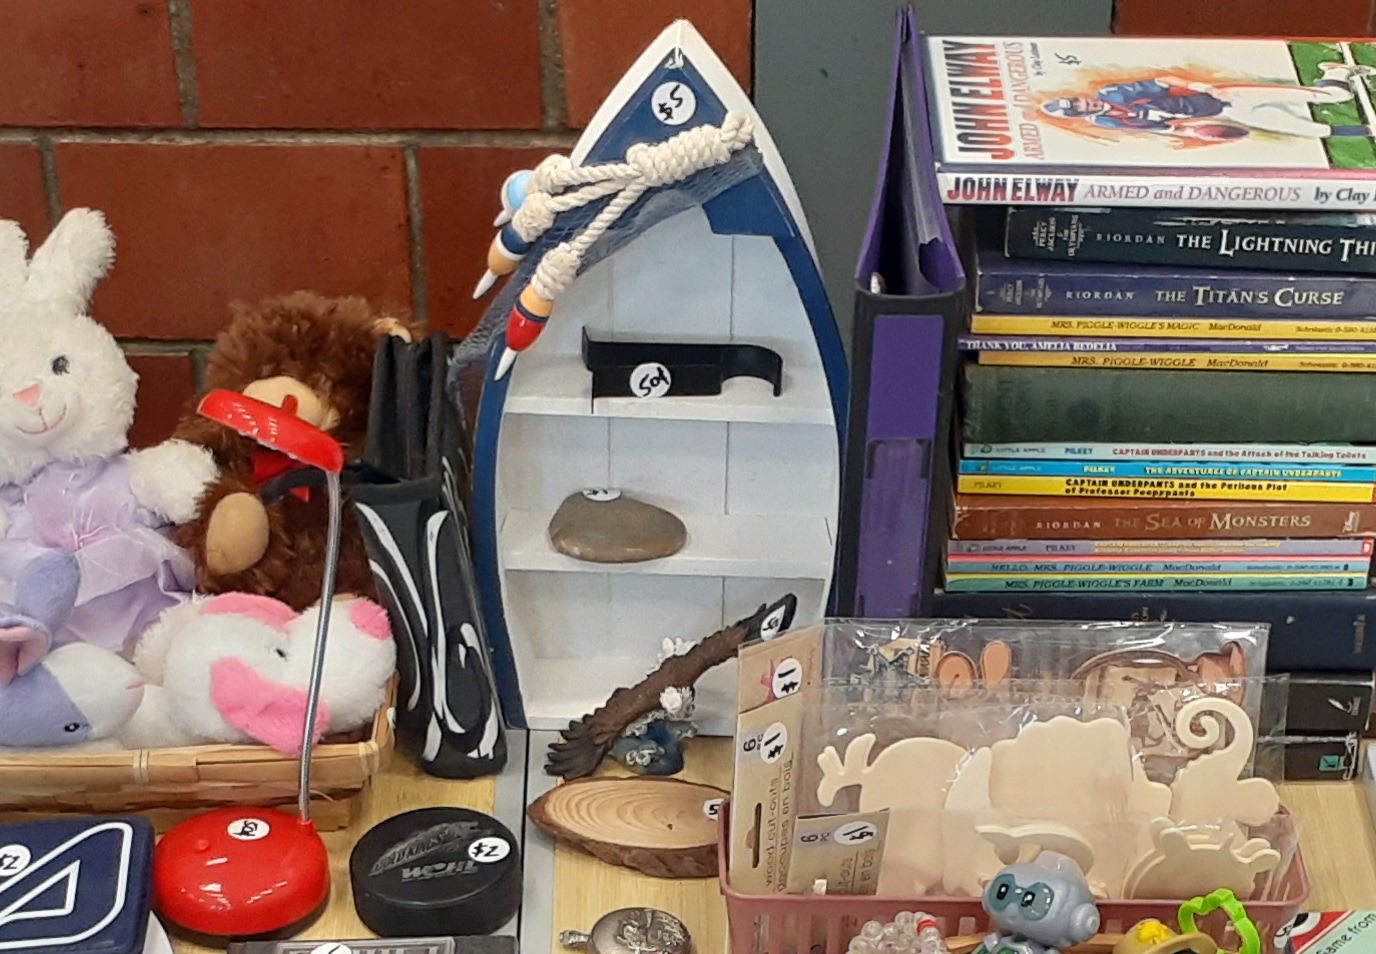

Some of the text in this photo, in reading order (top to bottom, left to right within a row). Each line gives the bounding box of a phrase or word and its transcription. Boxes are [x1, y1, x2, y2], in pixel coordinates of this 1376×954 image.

[942, 39, 1015, 160] JOHN ELWAY
[947, 176, 1008, 201] JOHN
[1010, 177, 1079, 202] ELWAY
[1083, 184, 1149, 200] ARMED
[1153, 185, 1184, 200] and
[1187, 186, 1301, 202] DANGEROUS
[1314, 186, 1332, 204] by
[1336, 187, 1369, 204] Clay
[1096, 233, 1165, 244] RIORDAN
[1176, 234, 1212, 249] THE
[1218, 229, 1332, 257] LIGHTNING
[1066, 291, 1135, 300] RIORDAN
[1156, 290, 1186, 302] THE
[1274, 288, 1345, 307] CURSE
[1208, 322, 1262, 332] MacDonald
[1207, 359, 1269, 368] MacDonald
[1036, 521, 1102, 530] RIORDAN
[1209, 513, 1312, 530] MONSTERS
[474, 843, 500, 857] $2
